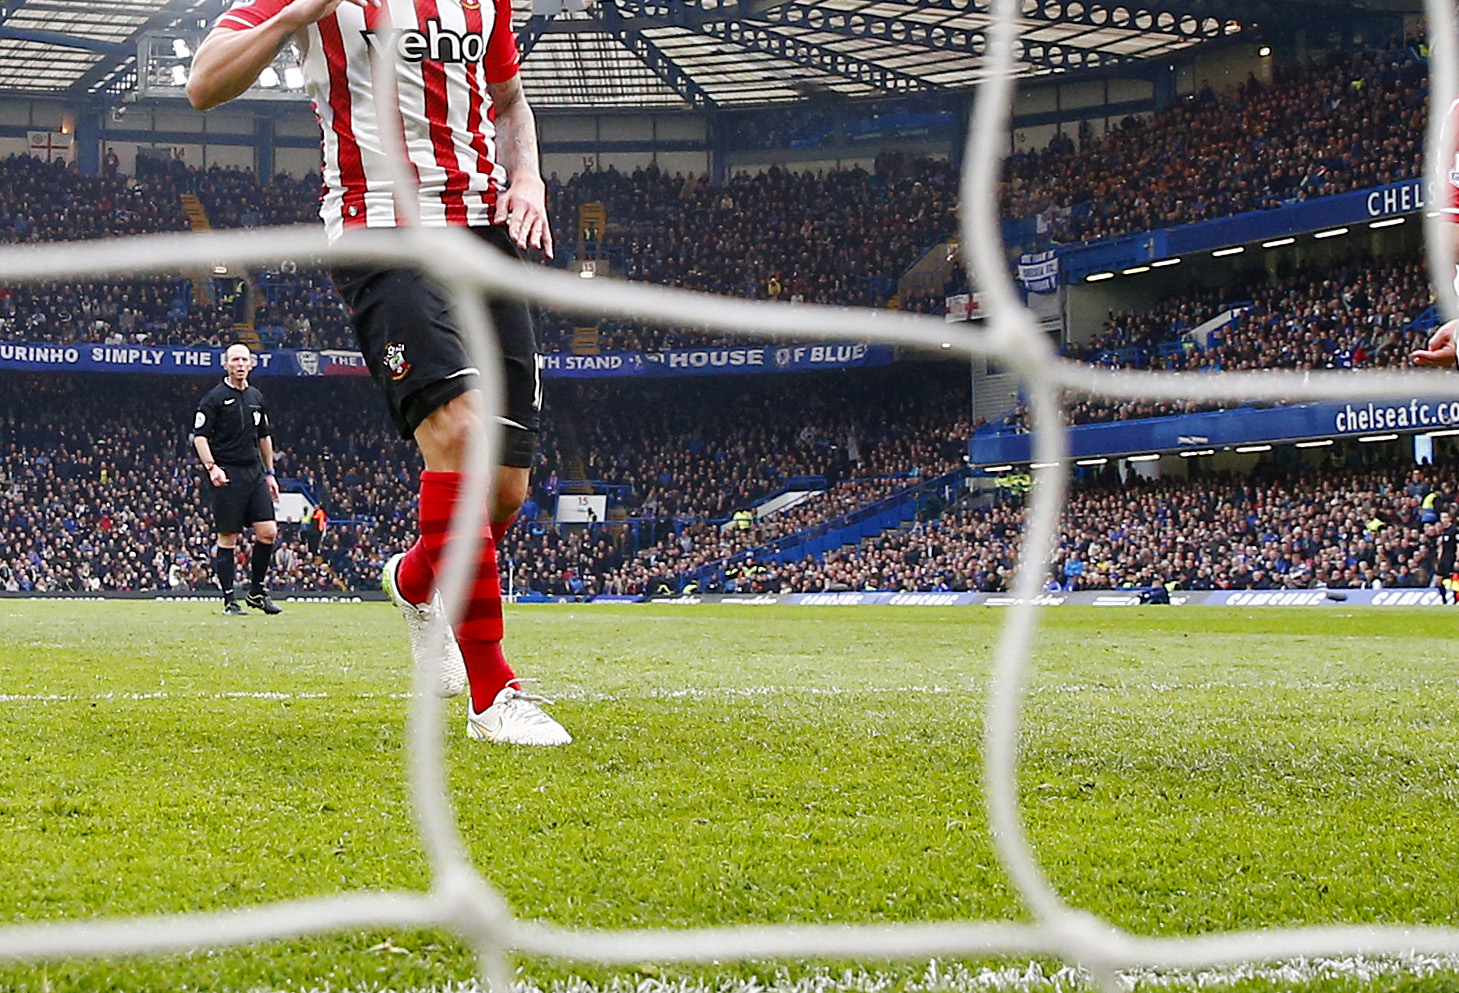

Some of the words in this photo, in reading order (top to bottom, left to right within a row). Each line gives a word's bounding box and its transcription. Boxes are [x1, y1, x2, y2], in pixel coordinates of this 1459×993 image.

[361, 18, 484, 63] veho
[92, 348, 165, 366] SIMPLY
[172, 350, 212, 367] THE
[565, 356, 623, 370] STAND
[669, 349, 765, 368] HOUSE
[810, 343, 869, 362] BLUE
[578, 497, 589, 506] 15
